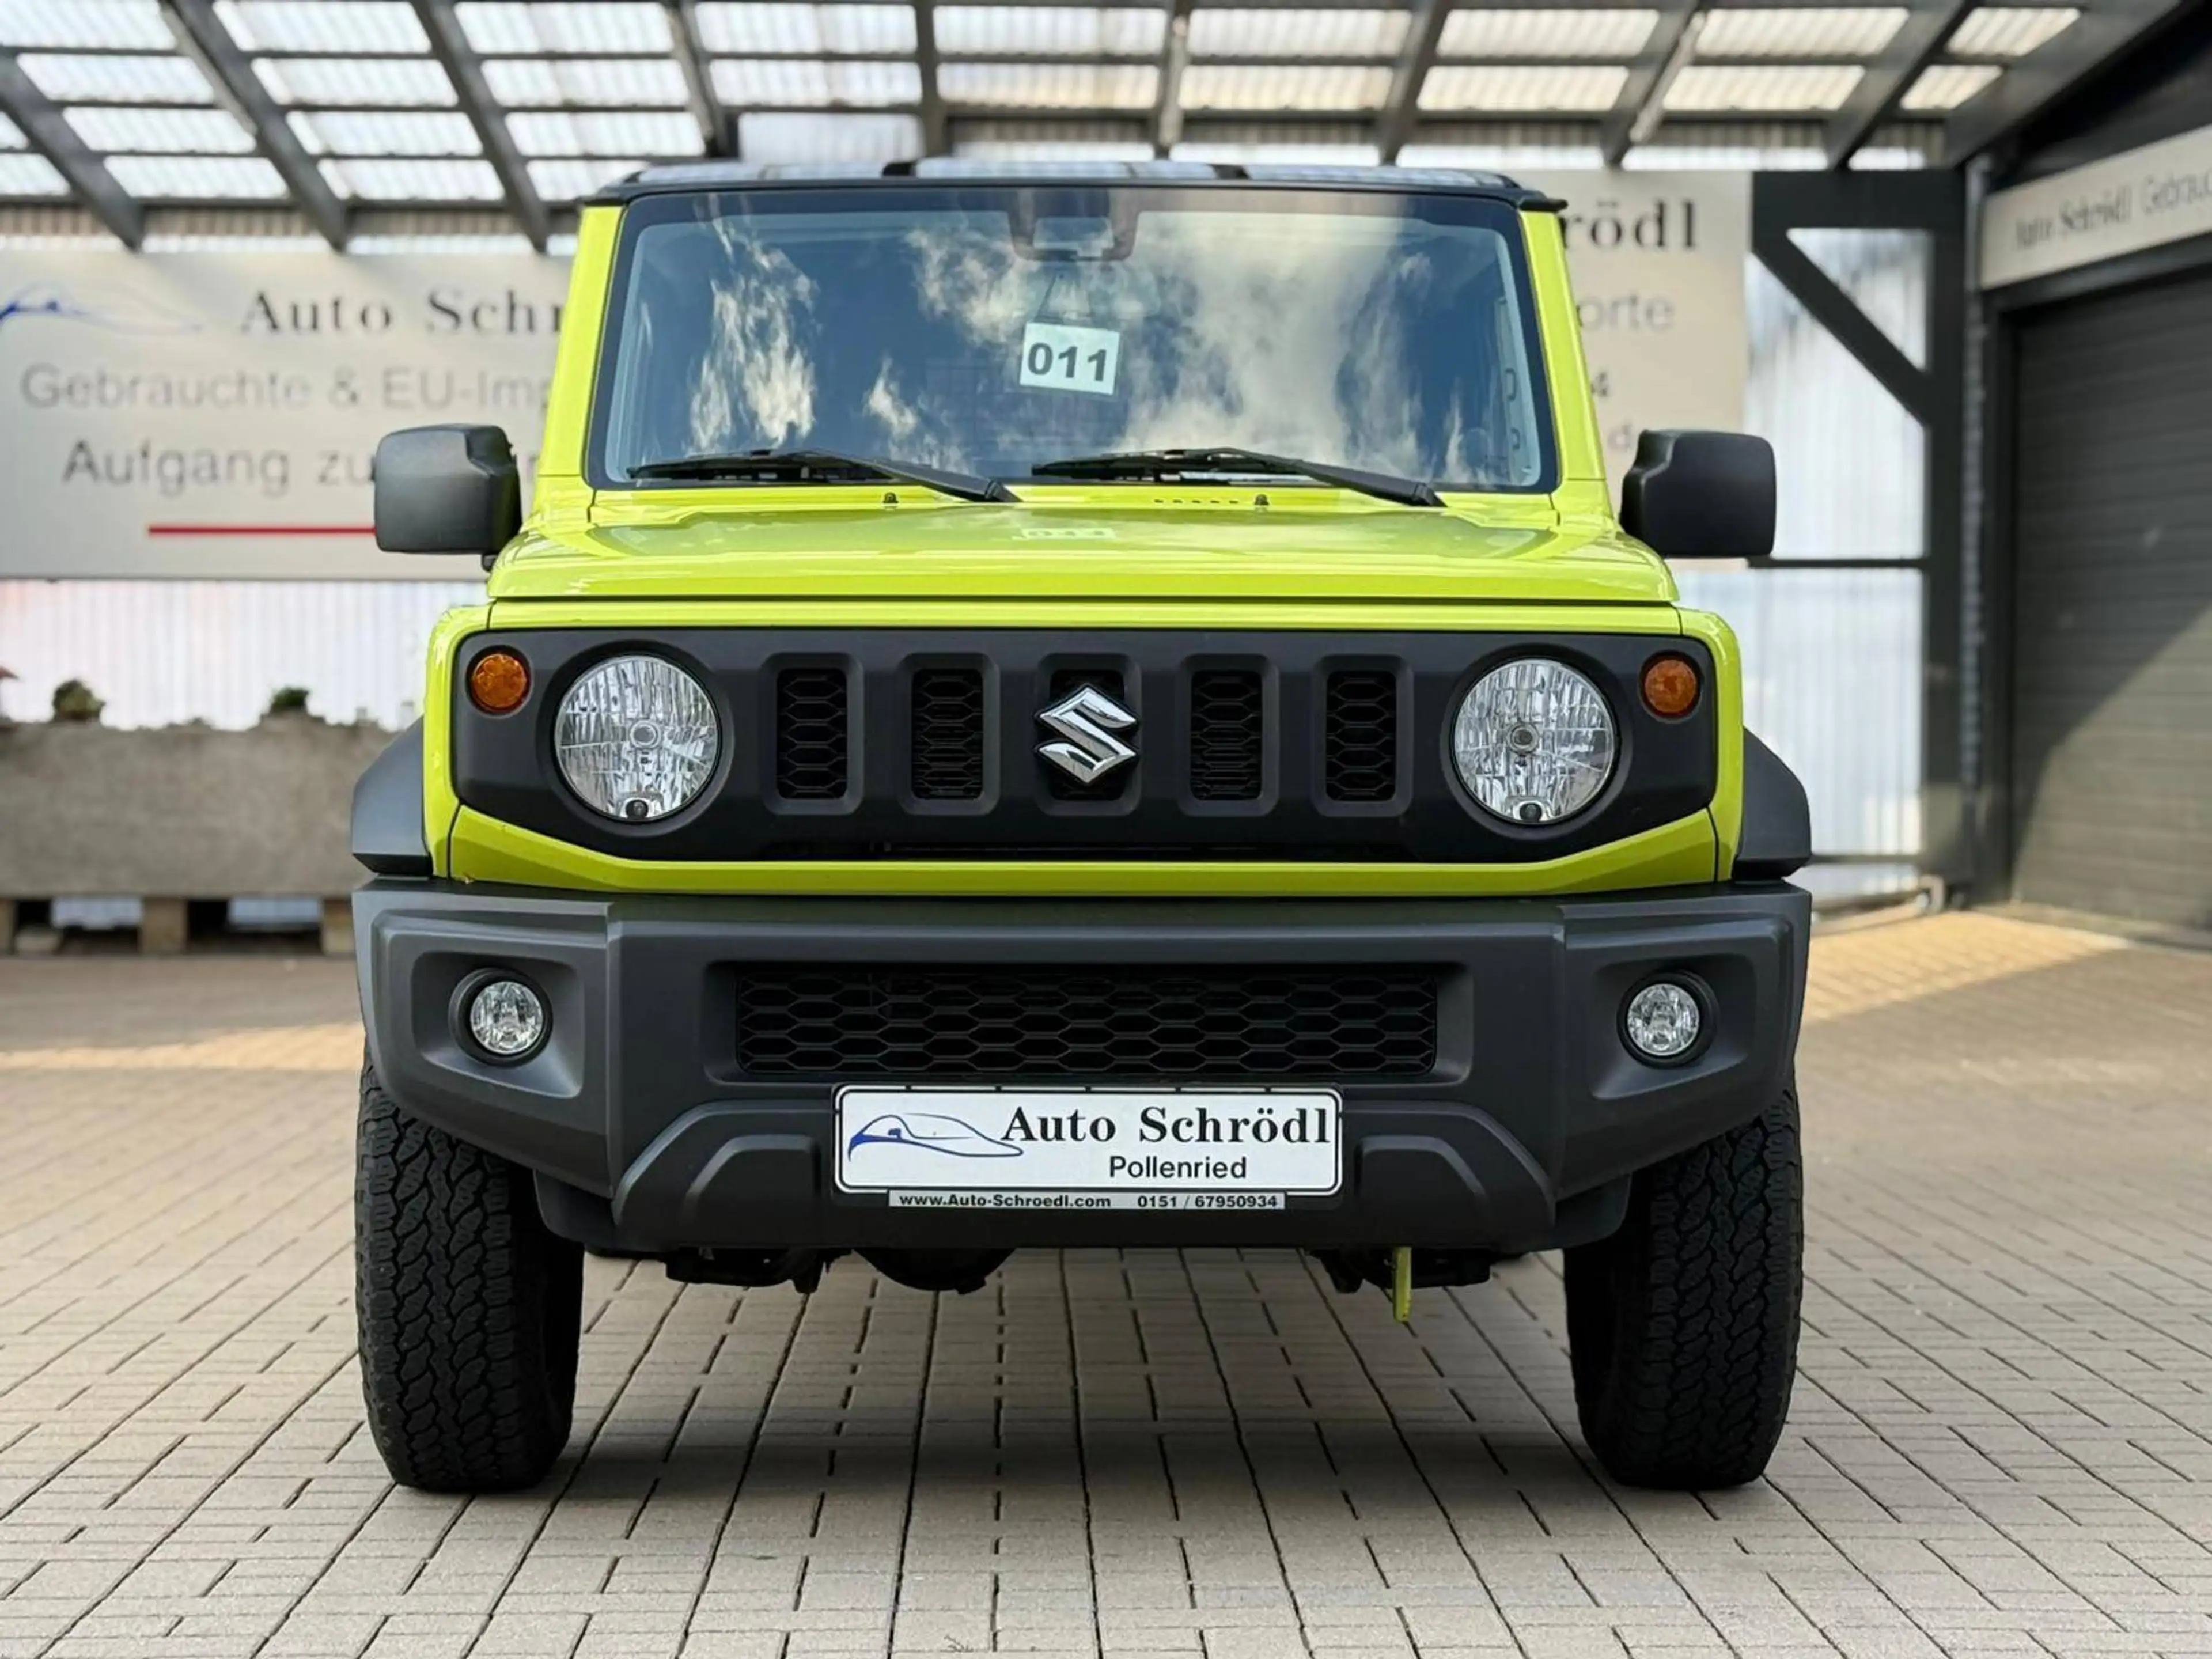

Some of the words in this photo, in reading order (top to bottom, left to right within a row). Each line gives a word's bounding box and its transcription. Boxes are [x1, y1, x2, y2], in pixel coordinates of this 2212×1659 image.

[241, 290, 392, 333] Auto
[1028, 342, 1107, 382] 011
[20, 361, 312, 410] Gebrauchte
[328, 366, 359, 410] &
[62, 438, 289, 497] Aufgang
[1001, 1106, 1116, 1142] Auto
[1139, 1105, 1330, 1144] Schrödl
[1109, 1156, 1247, 1179] Pollenried
[899, 1193, 1111, 1208] www.Auto-Schroedl.com
[1137, 1195, 1177, 1208] 0151
[1194, 1195, 1278, 1208] 67950934
